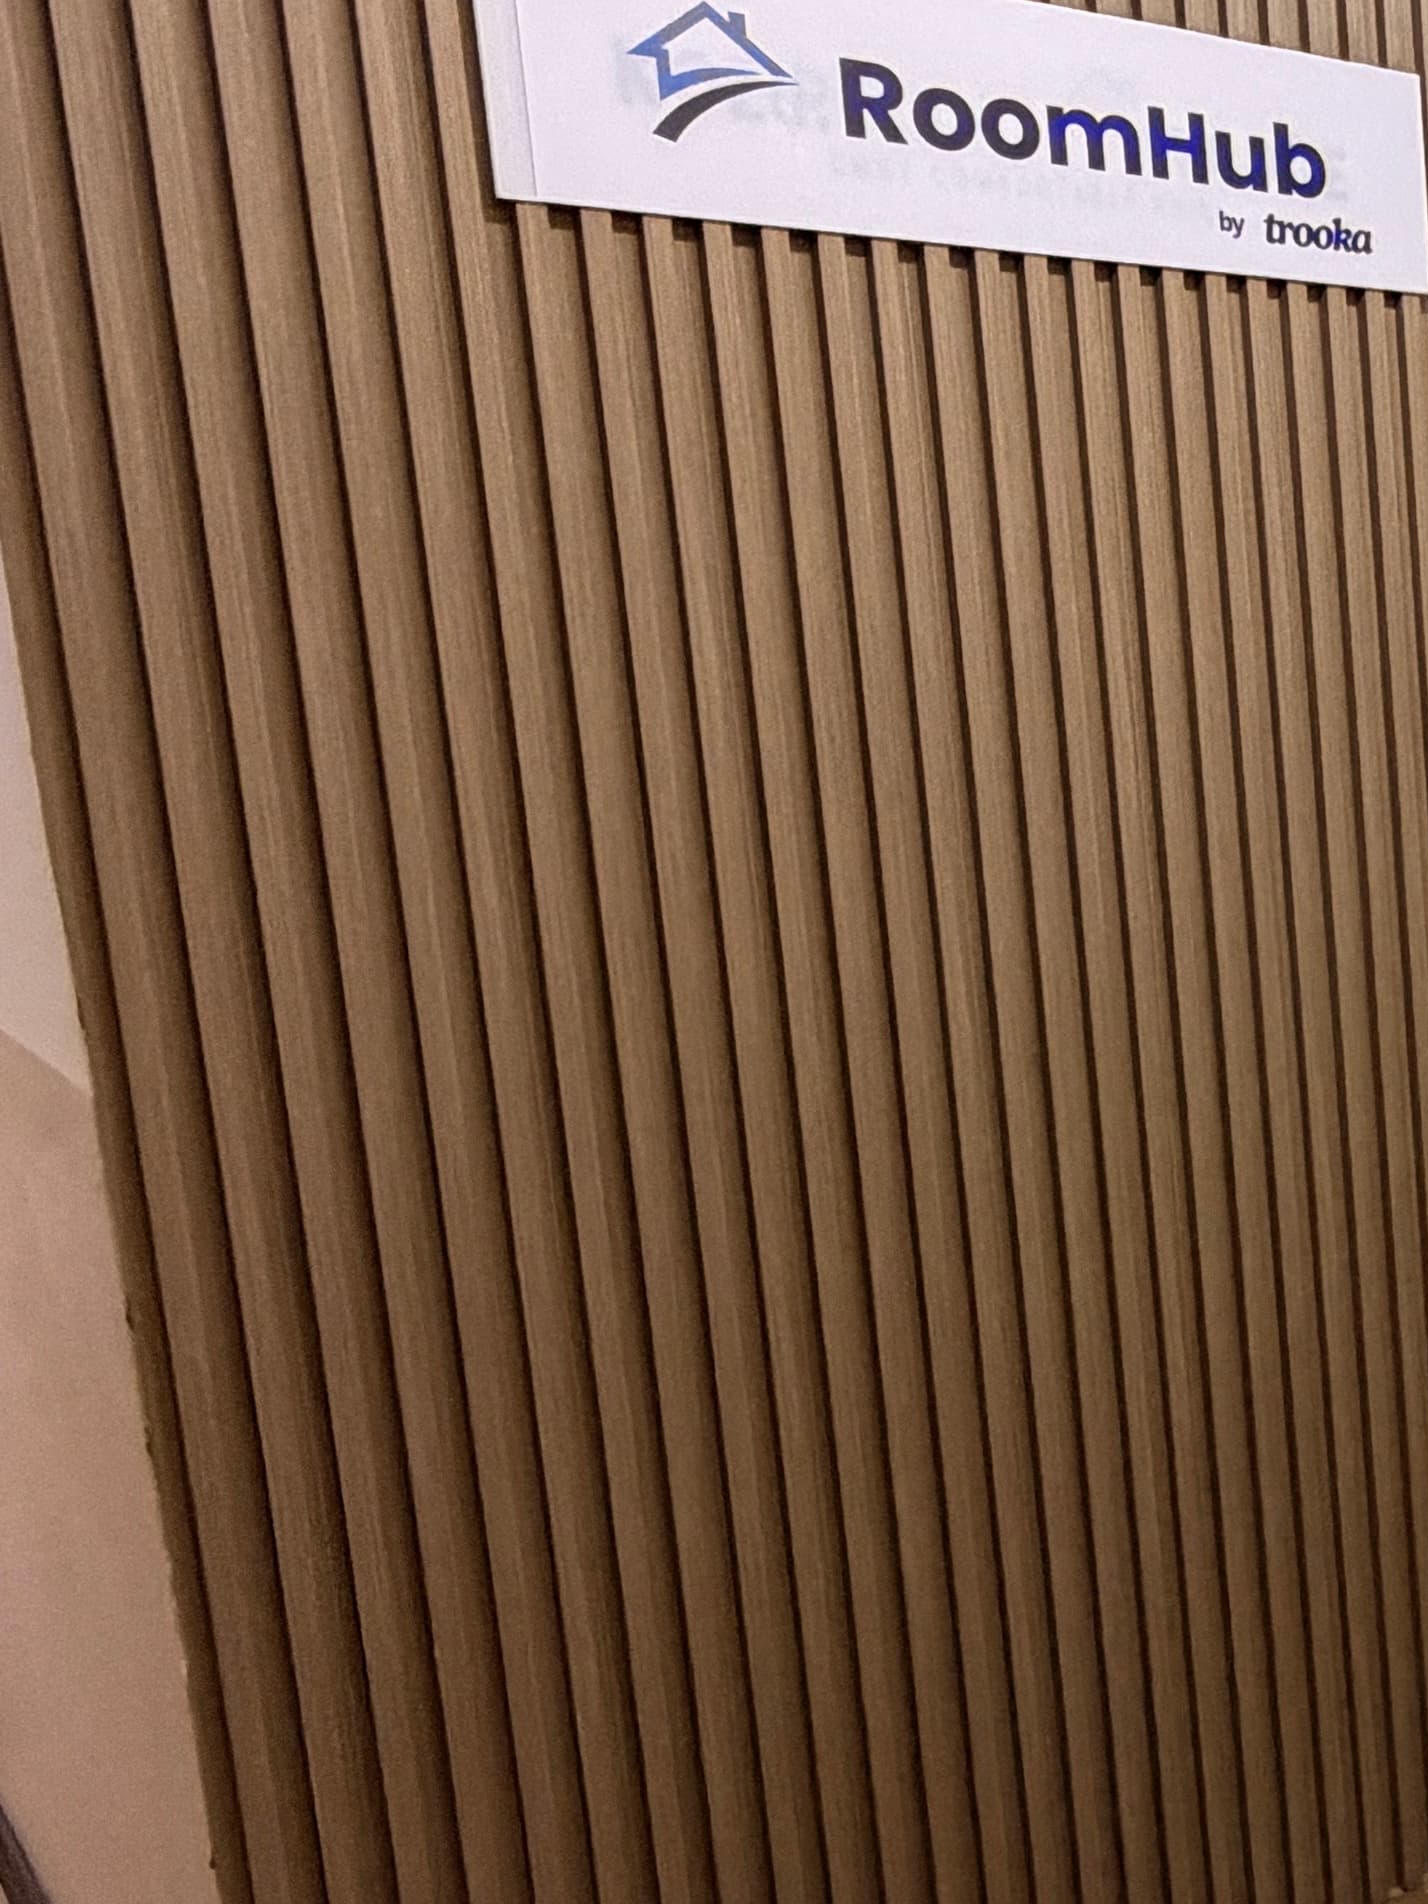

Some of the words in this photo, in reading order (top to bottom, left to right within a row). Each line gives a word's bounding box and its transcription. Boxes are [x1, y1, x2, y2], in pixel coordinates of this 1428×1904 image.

[838, 56, 1327, 198] RoomHub
[1218, 210, 1245, 239] by
[1264, 213, 1373, 255] trooka
